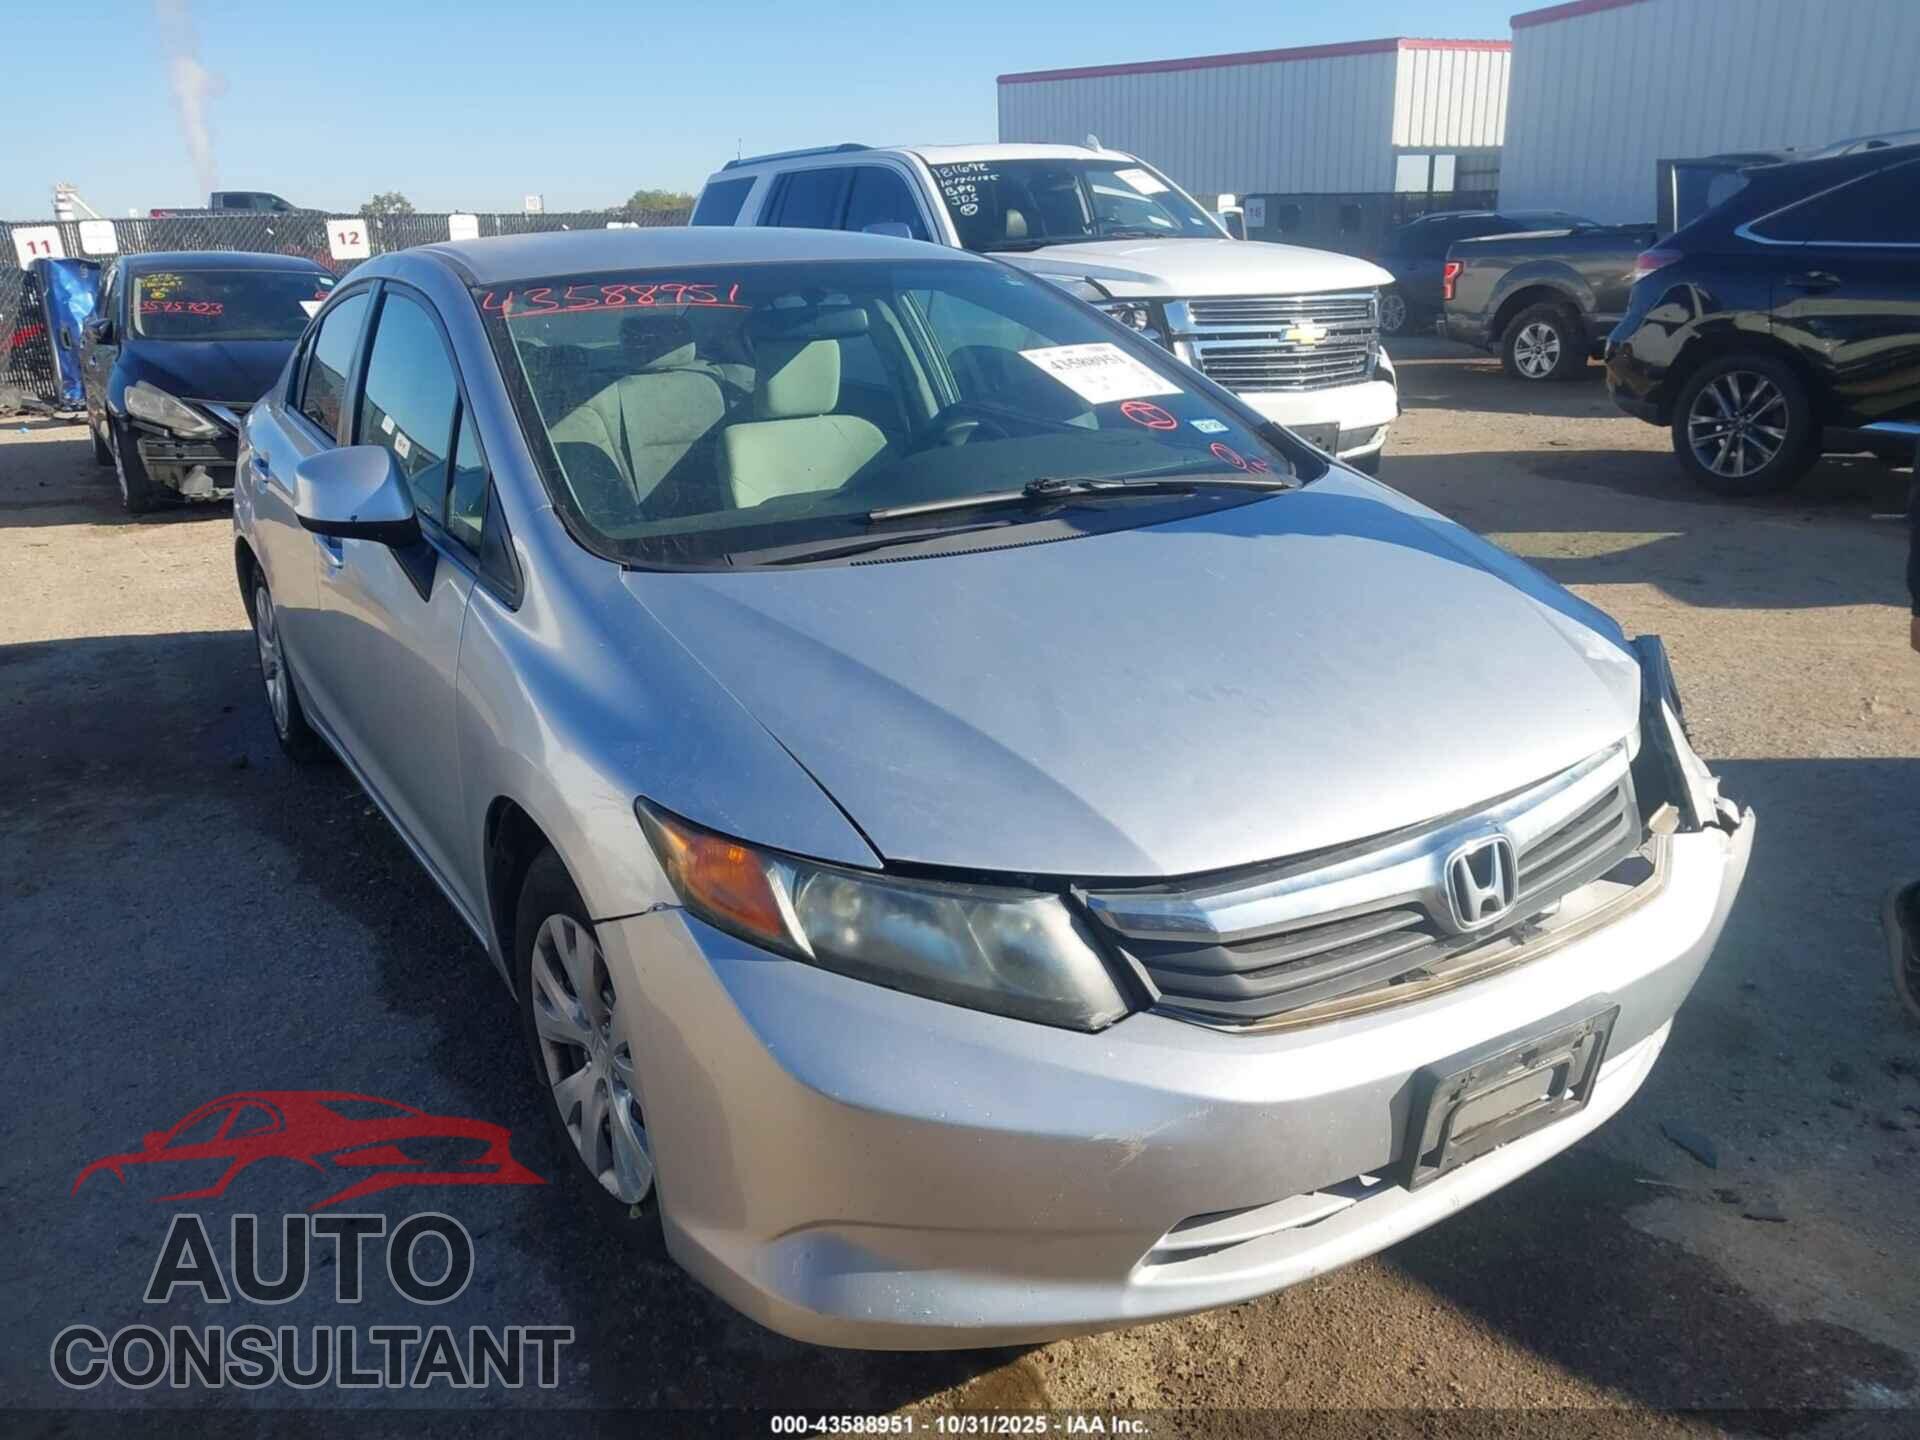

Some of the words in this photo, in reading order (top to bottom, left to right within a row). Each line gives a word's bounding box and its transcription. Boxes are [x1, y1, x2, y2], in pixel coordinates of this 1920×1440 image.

[338, 231, 360, 246] 12
[26, 240, 51, 255] 11
[482, 284, 739, 312] 43588951
